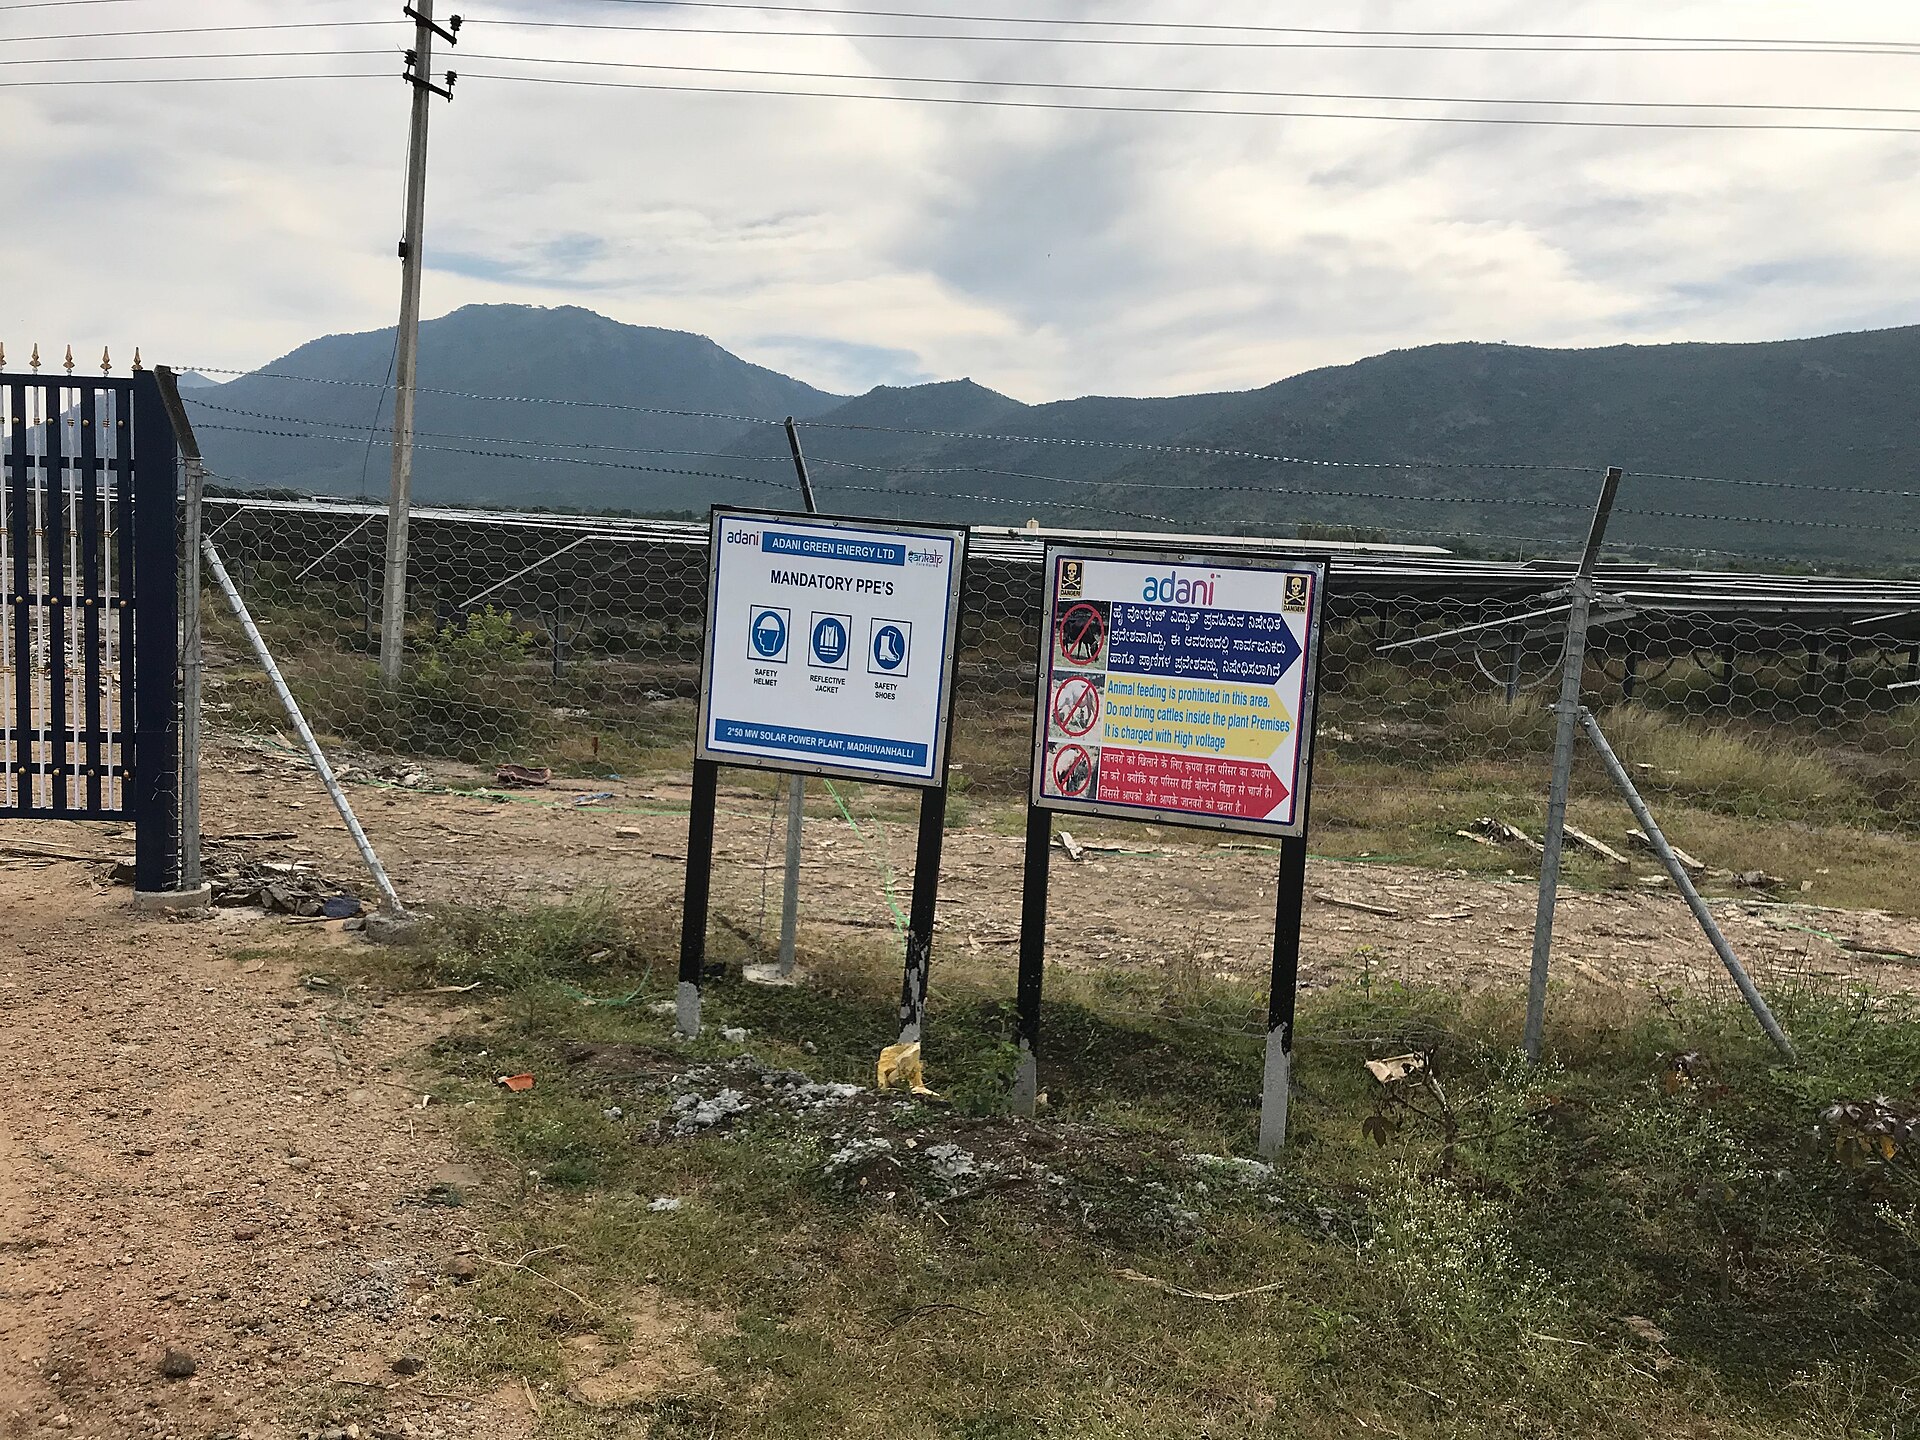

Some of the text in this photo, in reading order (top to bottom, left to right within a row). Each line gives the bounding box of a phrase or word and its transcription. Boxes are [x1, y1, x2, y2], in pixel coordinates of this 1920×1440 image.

[727, 529, 759, 546] adani
[772, 538, 895, 559] ADANI GREEN ENERGY LTD
[770, 570, 894, 596] MANDATORY PPE'S
[1143, 571, 1214, 606] adani
[1113, 605, 1123, 626] ಹೈ
[1170, 610, 1201, 631] ವಿದ್ಯುತ್
[1171, 632, 1181, 646] ಈ
[1110, 651, 1135, 665] ಹಾಗೂ
[753, 677, 778, 687] HELMET
[754, 668, 778, 677] SAFETY
[809, 674, 846, 686] REFLECTIVE
[815, 685, 839, 694] JACKET
[874, 681, 898, 691] SAFETY
[874, 691, 896, 701] SHOES
[1107, 680, 1270, 708] Animal feeding is prohibited in this area.
[1106, 701, 1290, 732] Do not bring cattles inside the plant Premises
[744, 729, 759, 739] MW
[760, 731, 787, 742] SOLAR
[788, 734, 817, 747] POWER
[817, 738, 845, 751] PLANT,
[847, 741, 915, 758] MADHUVANHALLI
[1104, 723, 1226, 752] It is charged with High voltage
[1126, 752, 1136, 766] को
[1160, 755, 1168, 769] के
[1170, 756, 1183, 773] लिए
[1204, 763, 1216, 775] इस
[1217, 762, 1237, 776] परिसर
[1239, 766, 1248, 777] का
[1250, 765, 1272, 780] उपयोग
[1101, 770, 1108, 781] ना
[1149, 775, 1159, 787] यह
[1160, 774, 1180, 789] परिसर
[1181, 775, 1193, 791] हाई
[1238, 781, 1246, 796] से
[1247, 784, 1263, 797] चार्ज
[1146, 789, 1158, 803] और
[1205, 797, 1215, 810] को
